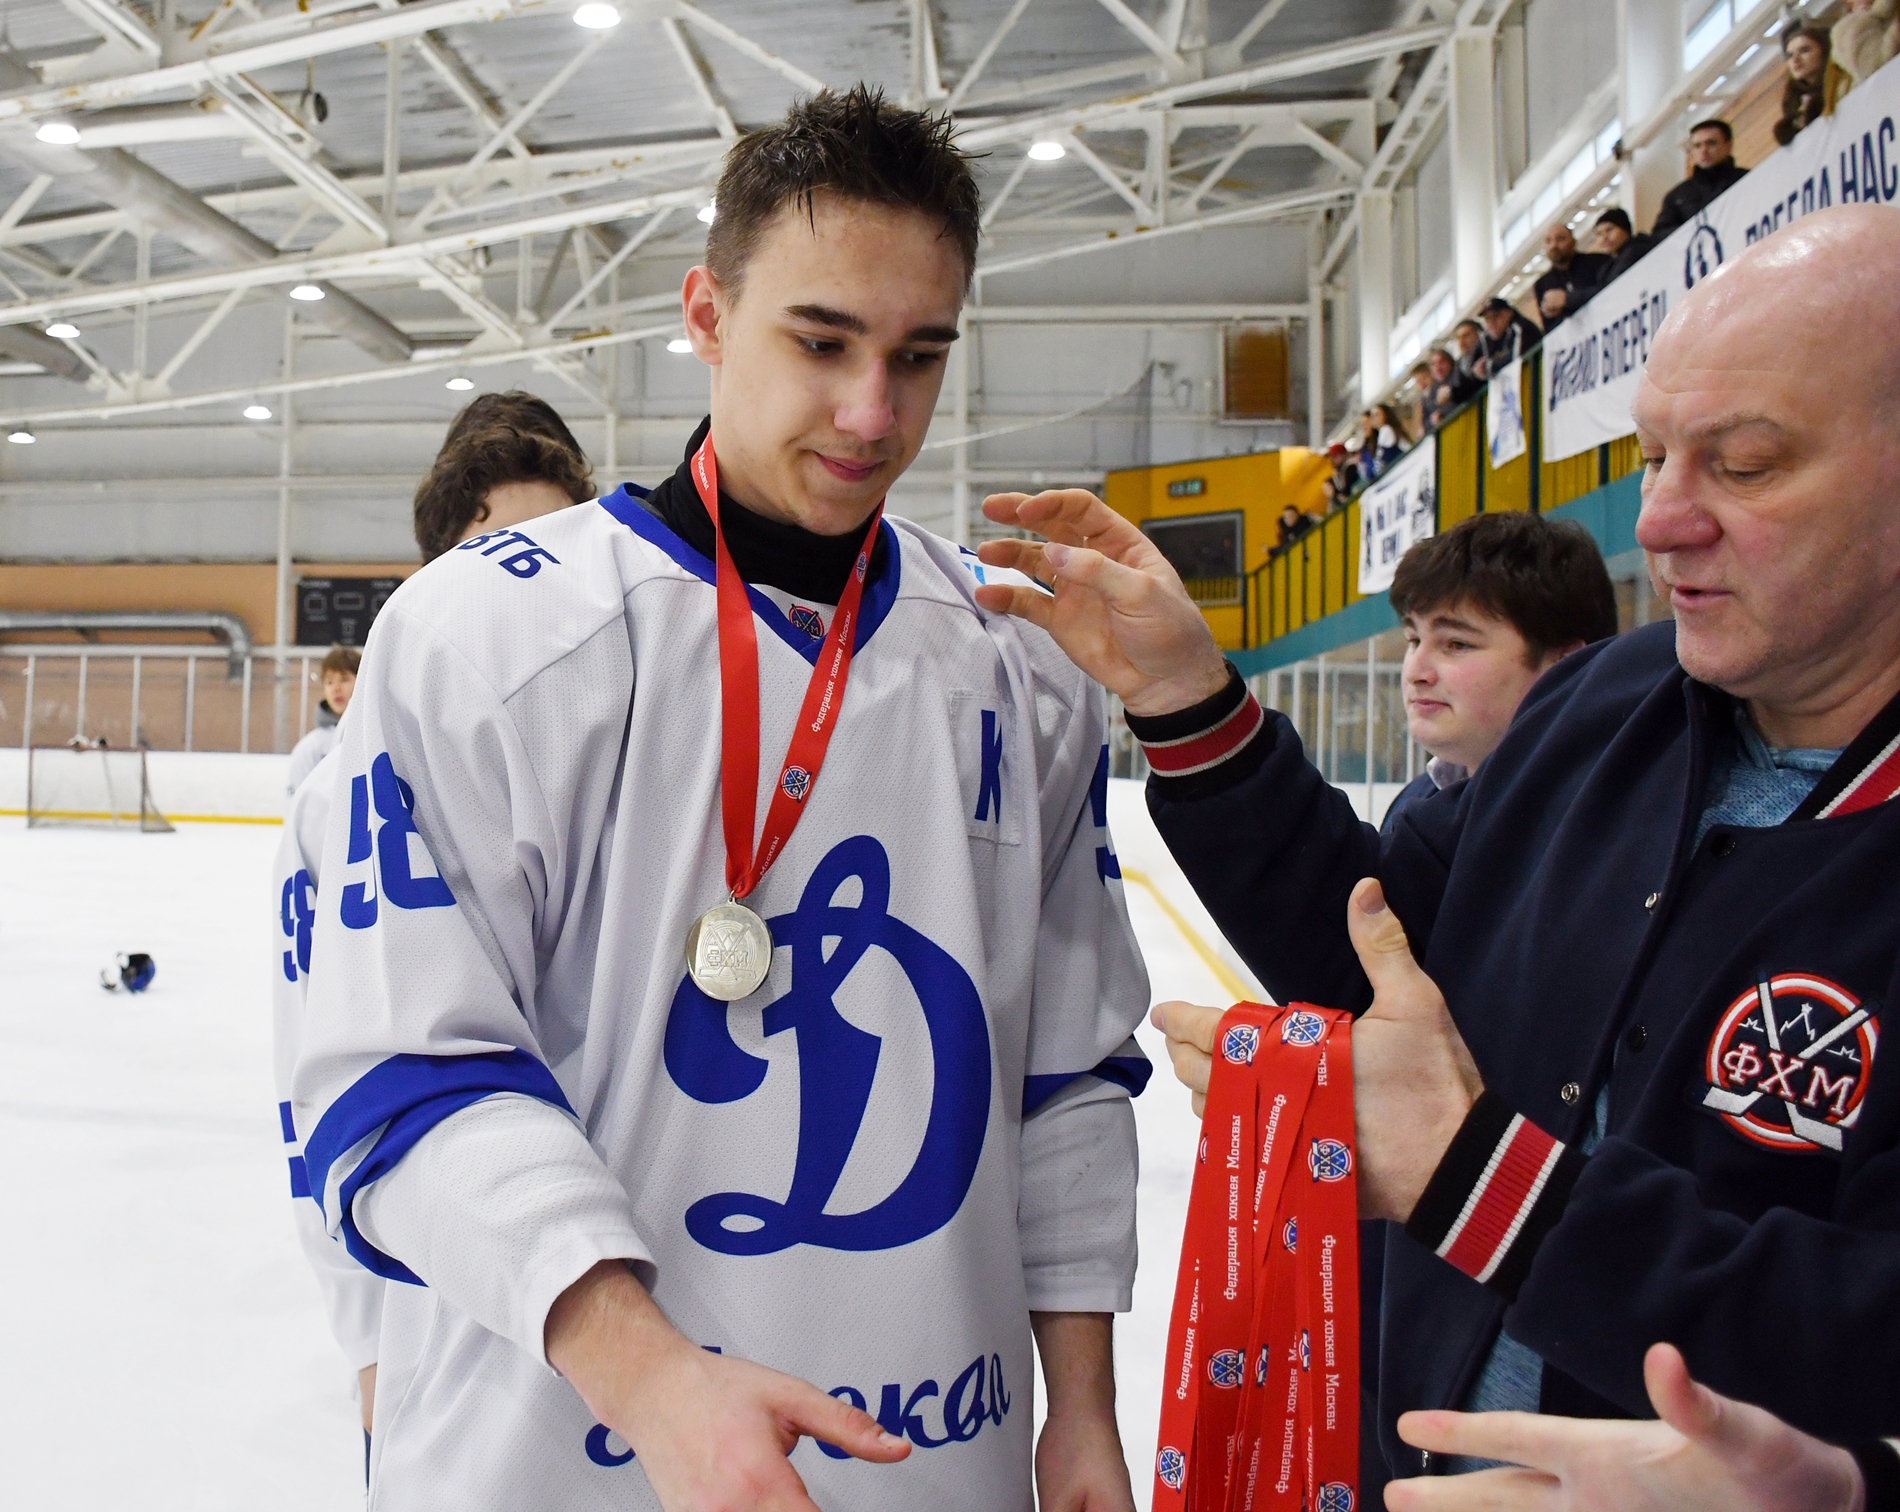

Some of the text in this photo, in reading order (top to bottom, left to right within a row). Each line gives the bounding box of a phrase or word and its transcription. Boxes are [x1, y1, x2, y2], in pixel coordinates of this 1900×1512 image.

[1840, 117, 1898, 204] НАС
[811, 610, 852, 732] Федерация хоккея Москвы
[760, 835, 780, 876] Москвы
[1722, 1043, 1857, 1118] ФХМ
[1262, 1094, 1287, 1165] Федерация
[1223, 1114, 1241, 1300] Федерация хоккея Москвы
[1176, 1327, 1195, 1400] Федерация
[1319, 1234, 1339, 1431] Федерация хоккея Москвы
[1275, 1418, 1294, 1494] Федерация
